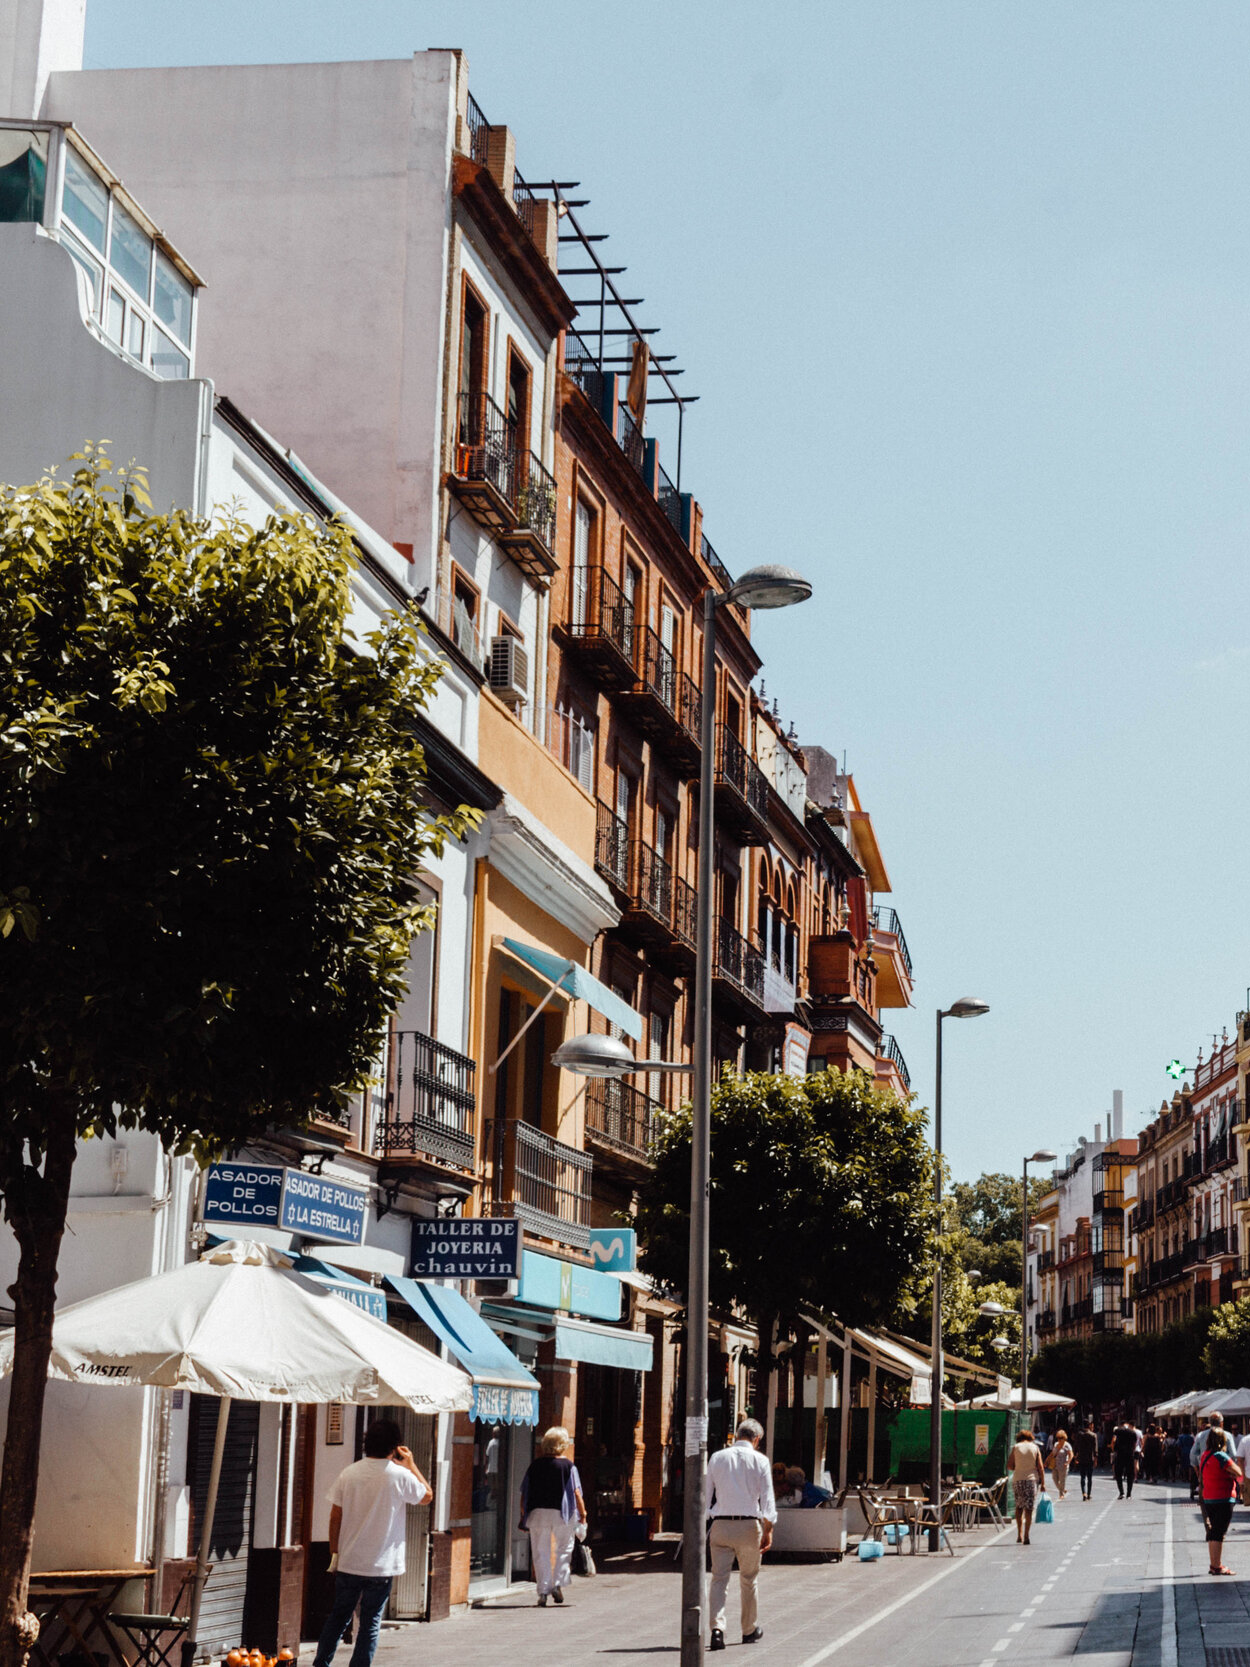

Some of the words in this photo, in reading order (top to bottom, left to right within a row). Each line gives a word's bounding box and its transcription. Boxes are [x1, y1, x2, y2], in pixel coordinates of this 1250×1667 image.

[208, 1169, 282, 1186] ASADOR
[233, 1187, 256, 1199] DE
[285, 1176, 320, 1201] ASADOR
[321, 1186, 333, 1204] DE
[334, 1189, 364, 1212] POLLOS
[207, 1200, 278, 1216] POLLOS
[296, 1207, 309, 1223] LA
[310, 1209, 351, 1234] ESTRELLA
[417, 1223, 484, 1236] TALLER
[490, 1223, 515, 1236] DE
[426, 1242, 503, 1255] JOYERIA
[414, 1258, 513, 1273] chauvin
[74, 1362, 133, 1377] AMSTEL
